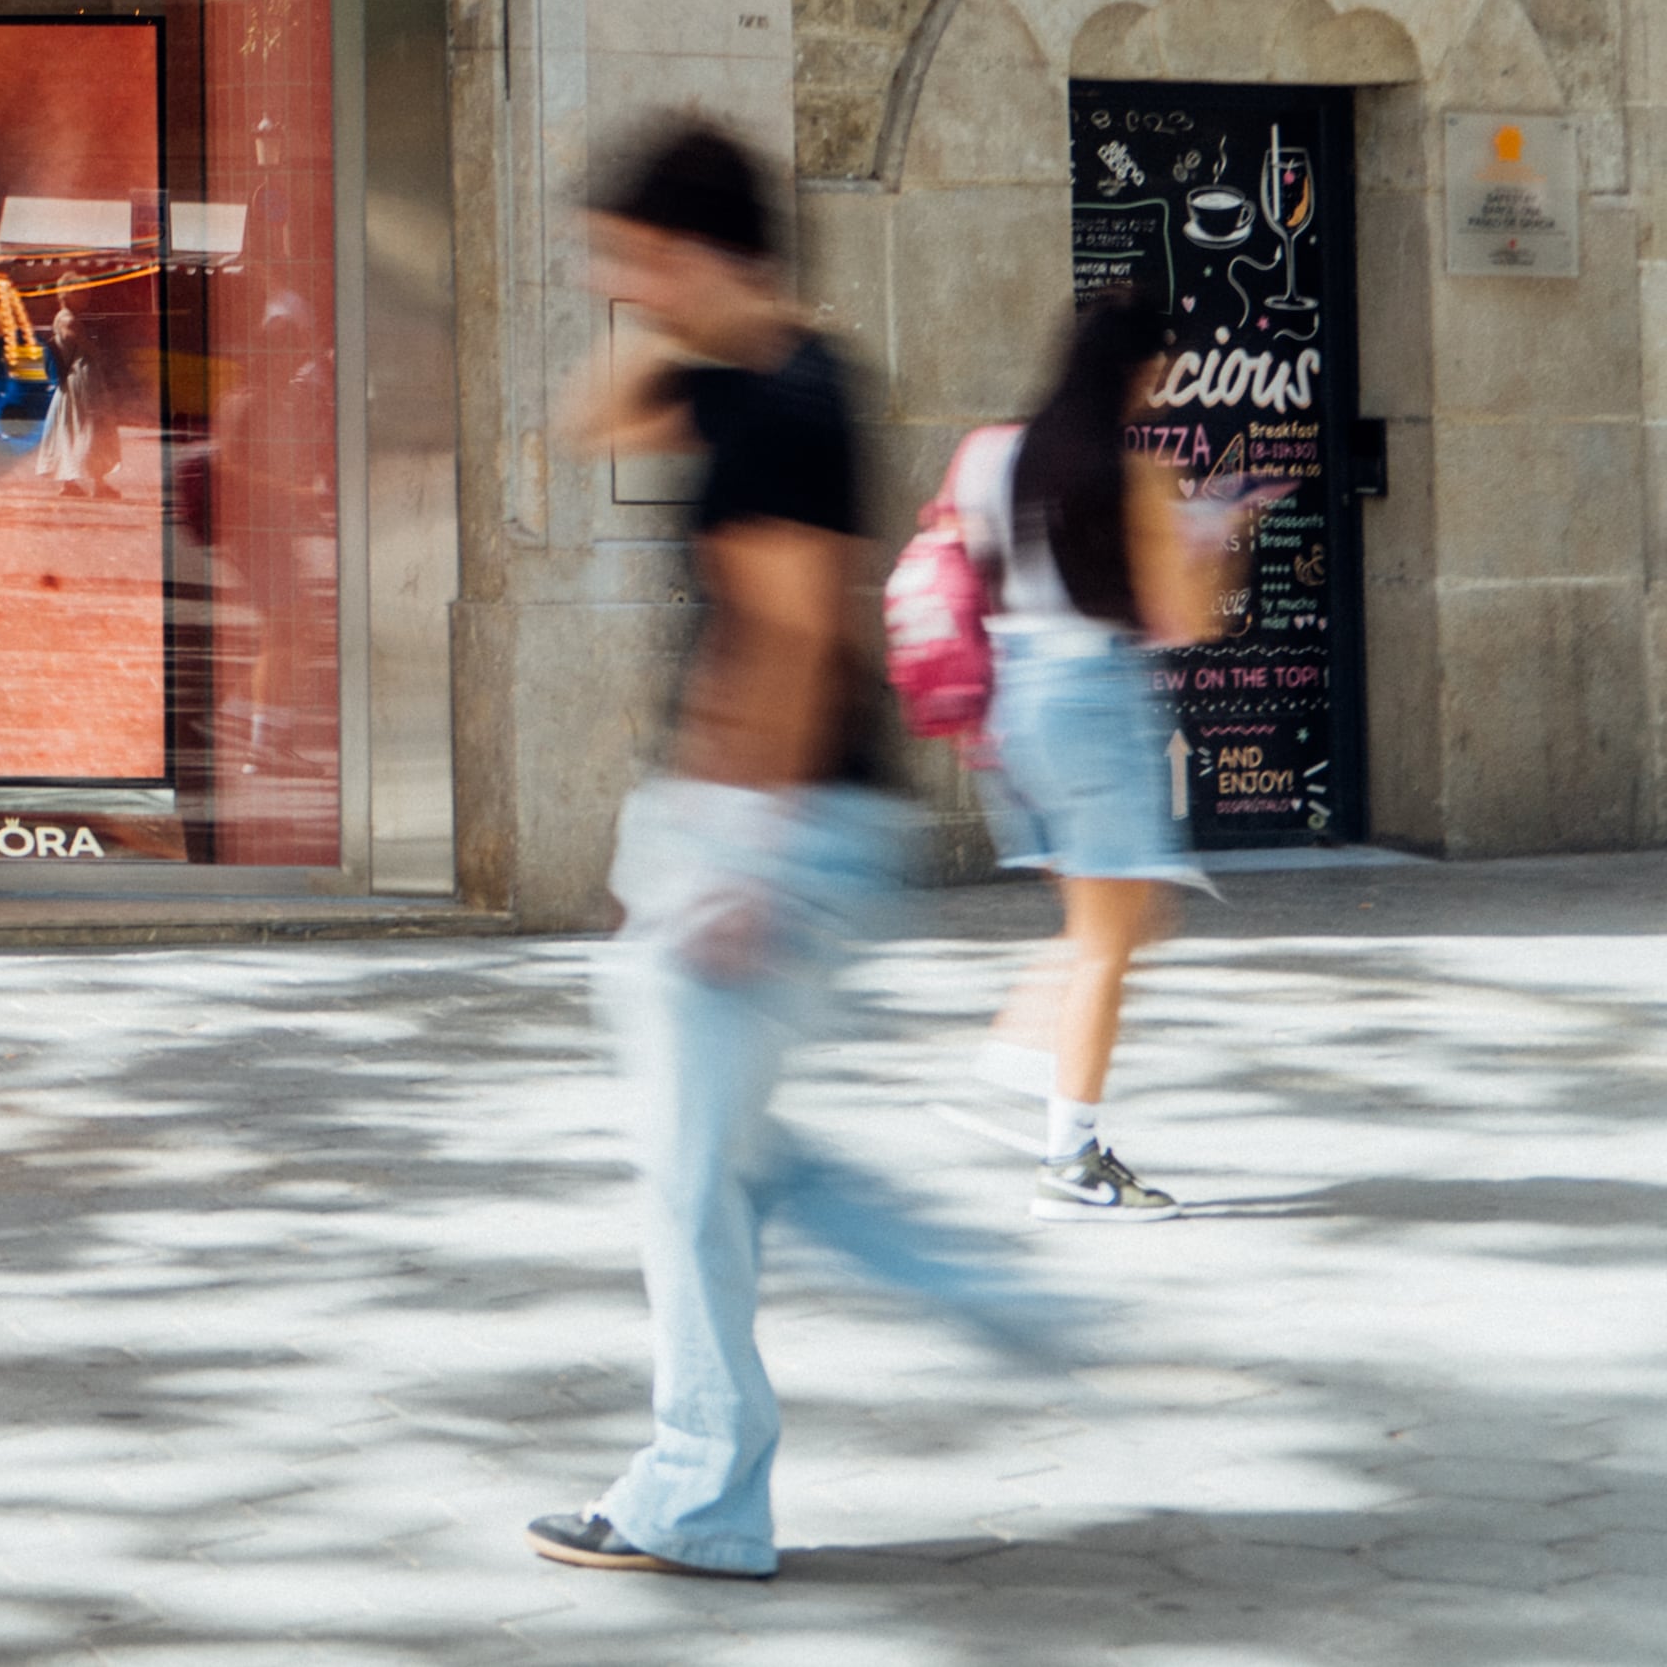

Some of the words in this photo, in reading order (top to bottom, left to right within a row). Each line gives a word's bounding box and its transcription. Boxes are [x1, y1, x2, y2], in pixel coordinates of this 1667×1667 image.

[1146, 325, 1321, 415] icious
[1249, 420, 1320, 439] Breakfast
[1194, 667, 1226, 690] ON
[1230, 665, 1269, 689] THE
[1218, 745, 1264, 769] AND
[1218, 769, 1294, 795] ENJOY!
